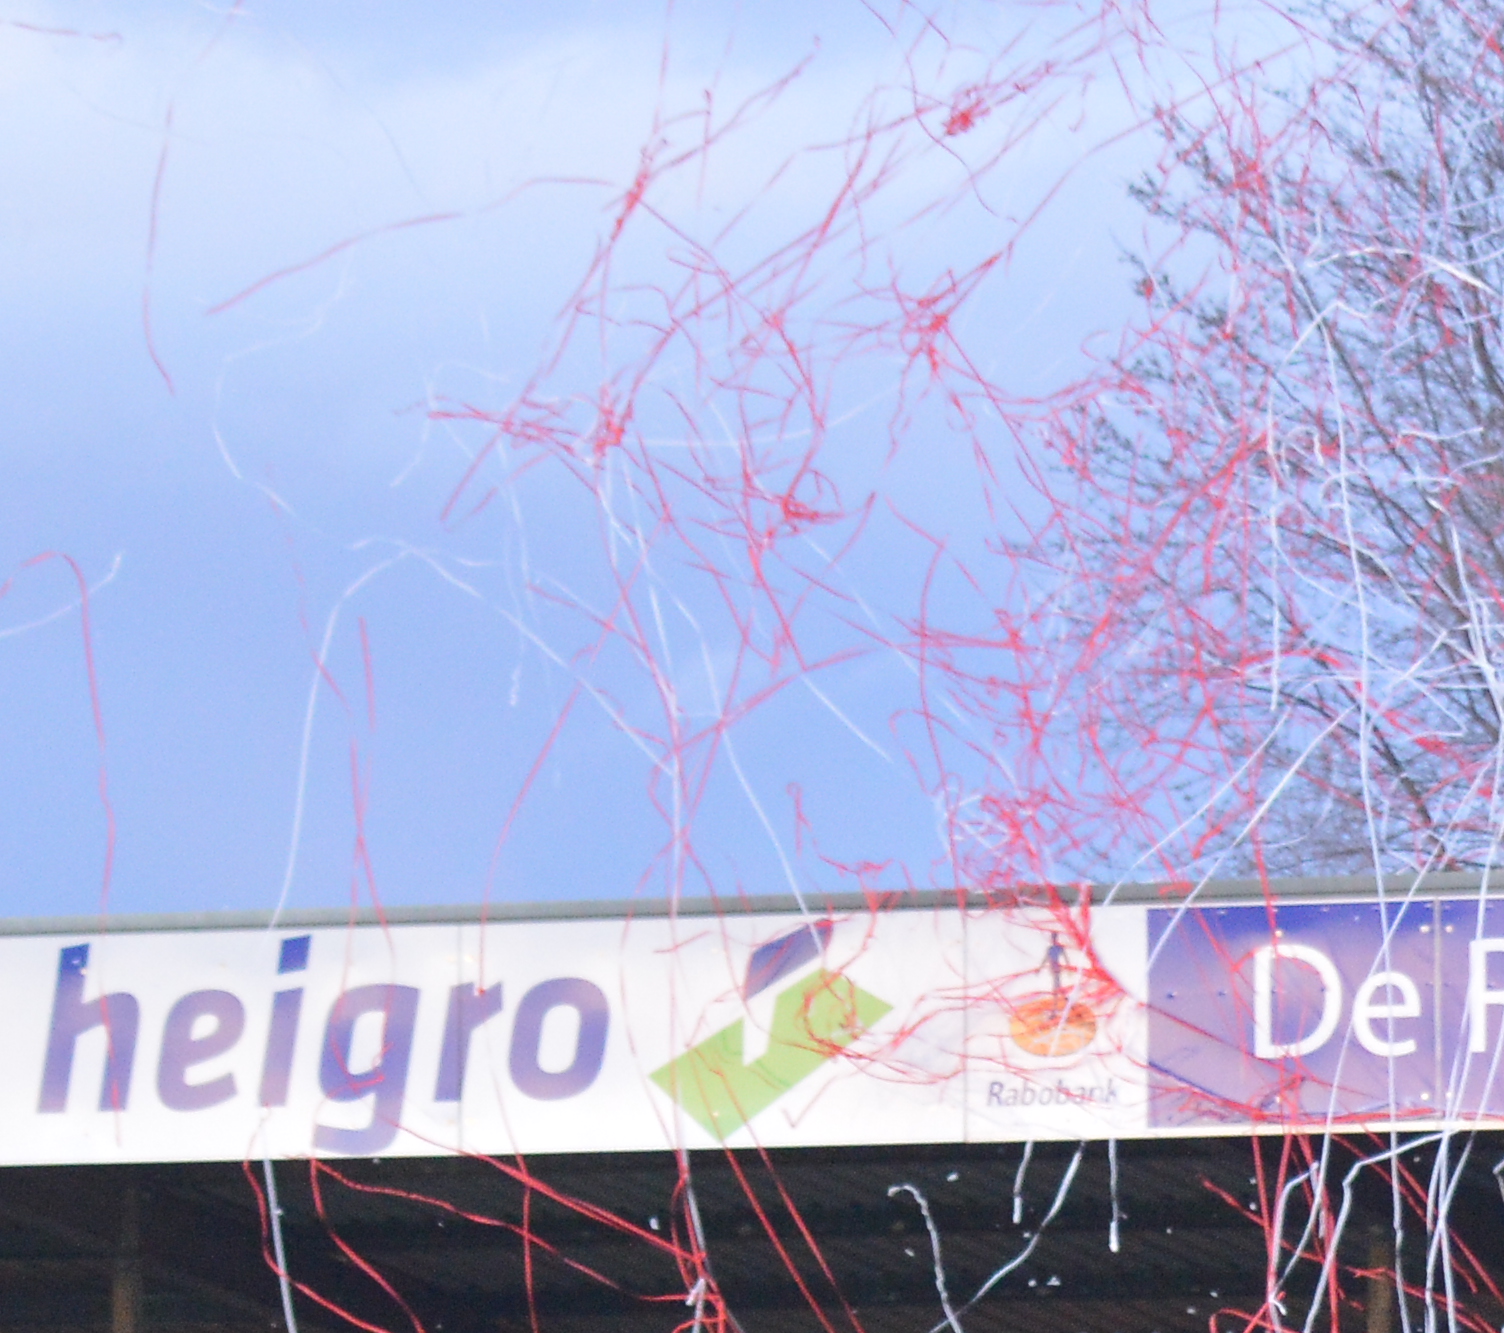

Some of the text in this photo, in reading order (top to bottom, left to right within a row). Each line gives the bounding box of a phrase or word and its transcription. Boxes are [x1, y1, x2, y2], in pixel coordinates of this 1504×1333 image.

[37, 934, 611, 1154] heigro
[1257, 941, 1421, 1059] De
[987, 1079, 1117, 1107] Rabobank
